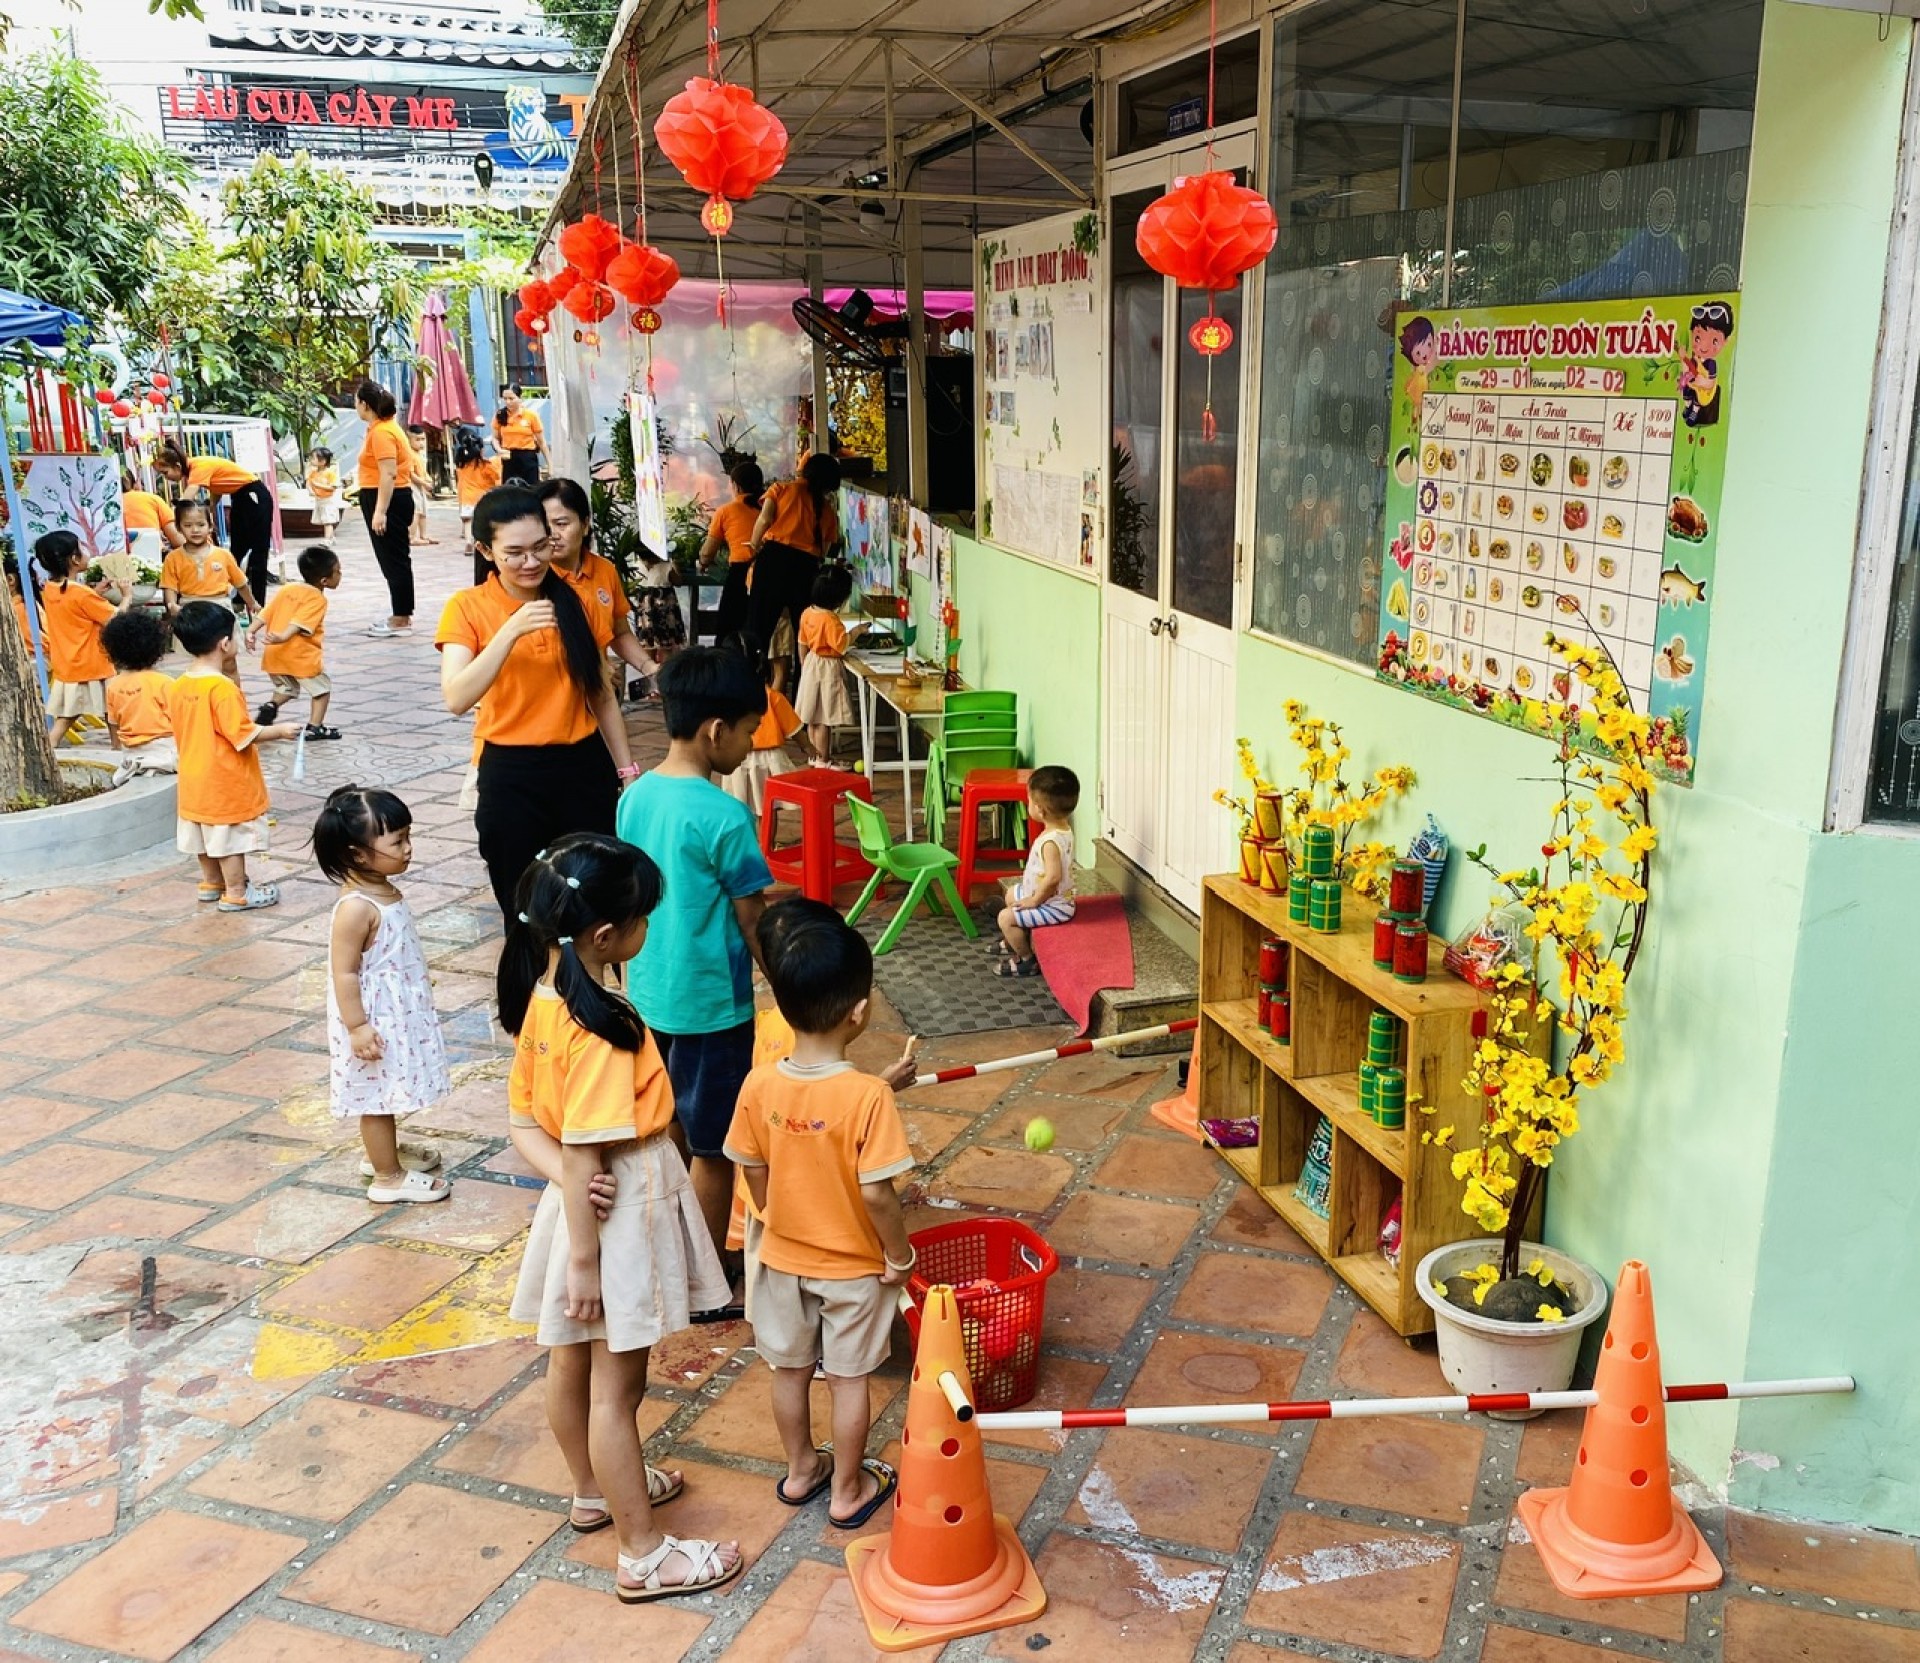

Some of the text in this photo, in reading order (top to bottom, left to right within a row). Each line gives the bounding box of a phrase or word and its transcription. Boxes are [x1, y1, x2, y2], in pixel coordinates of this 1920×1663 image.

[247, 88, 322, 124] CUA
[328, 87, 397, 127] CÂY
[406, 96, 459, 130] ME
[1439, 309, 1675, 363] BẢNG THỰC ĐƠN TUẦN
[1479, 368, 1498, 389] 29
[1512, 368, 1530, 389] 01
[1566, 365, 1585, 389] 02
[1602, 369, 1625, 393] 02
[1446, 405, 1472, 426] Sáng
